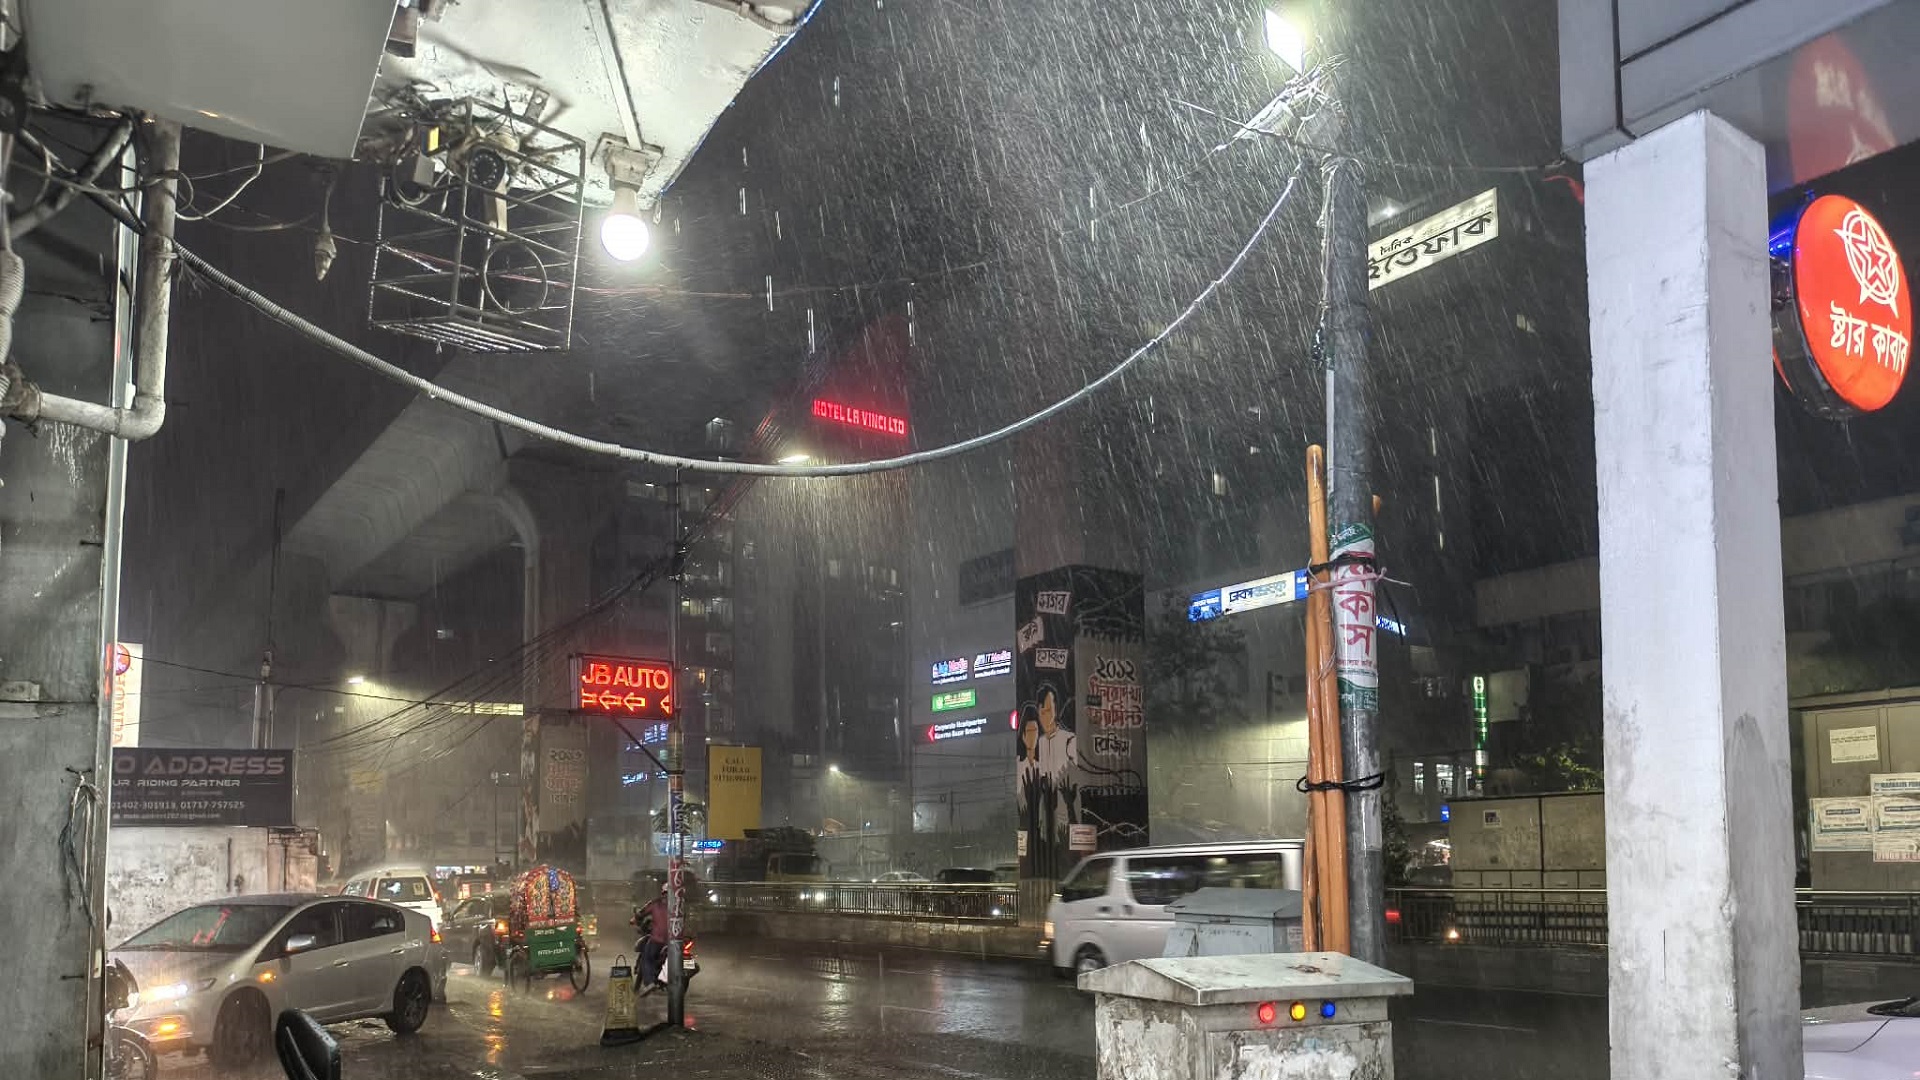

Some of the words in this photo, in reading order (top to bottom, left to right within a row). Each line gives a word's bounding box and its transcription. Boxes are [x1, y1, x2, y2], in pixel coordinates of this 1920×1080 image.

[813, 400, 845, 421] HOTEL
[847, 407, 860, 425] LA
[861, 410, 887, 431] VINCI
[888, 416, 905, 434] LTD
[582, 663, 611, 685] JB
[612, 666, 670, 690] AUTO
[144, 756, 286, 775] ADDRESS
[137, 779, 178, 787] RIDING
[181, 779, 240, 787] PARTNER
